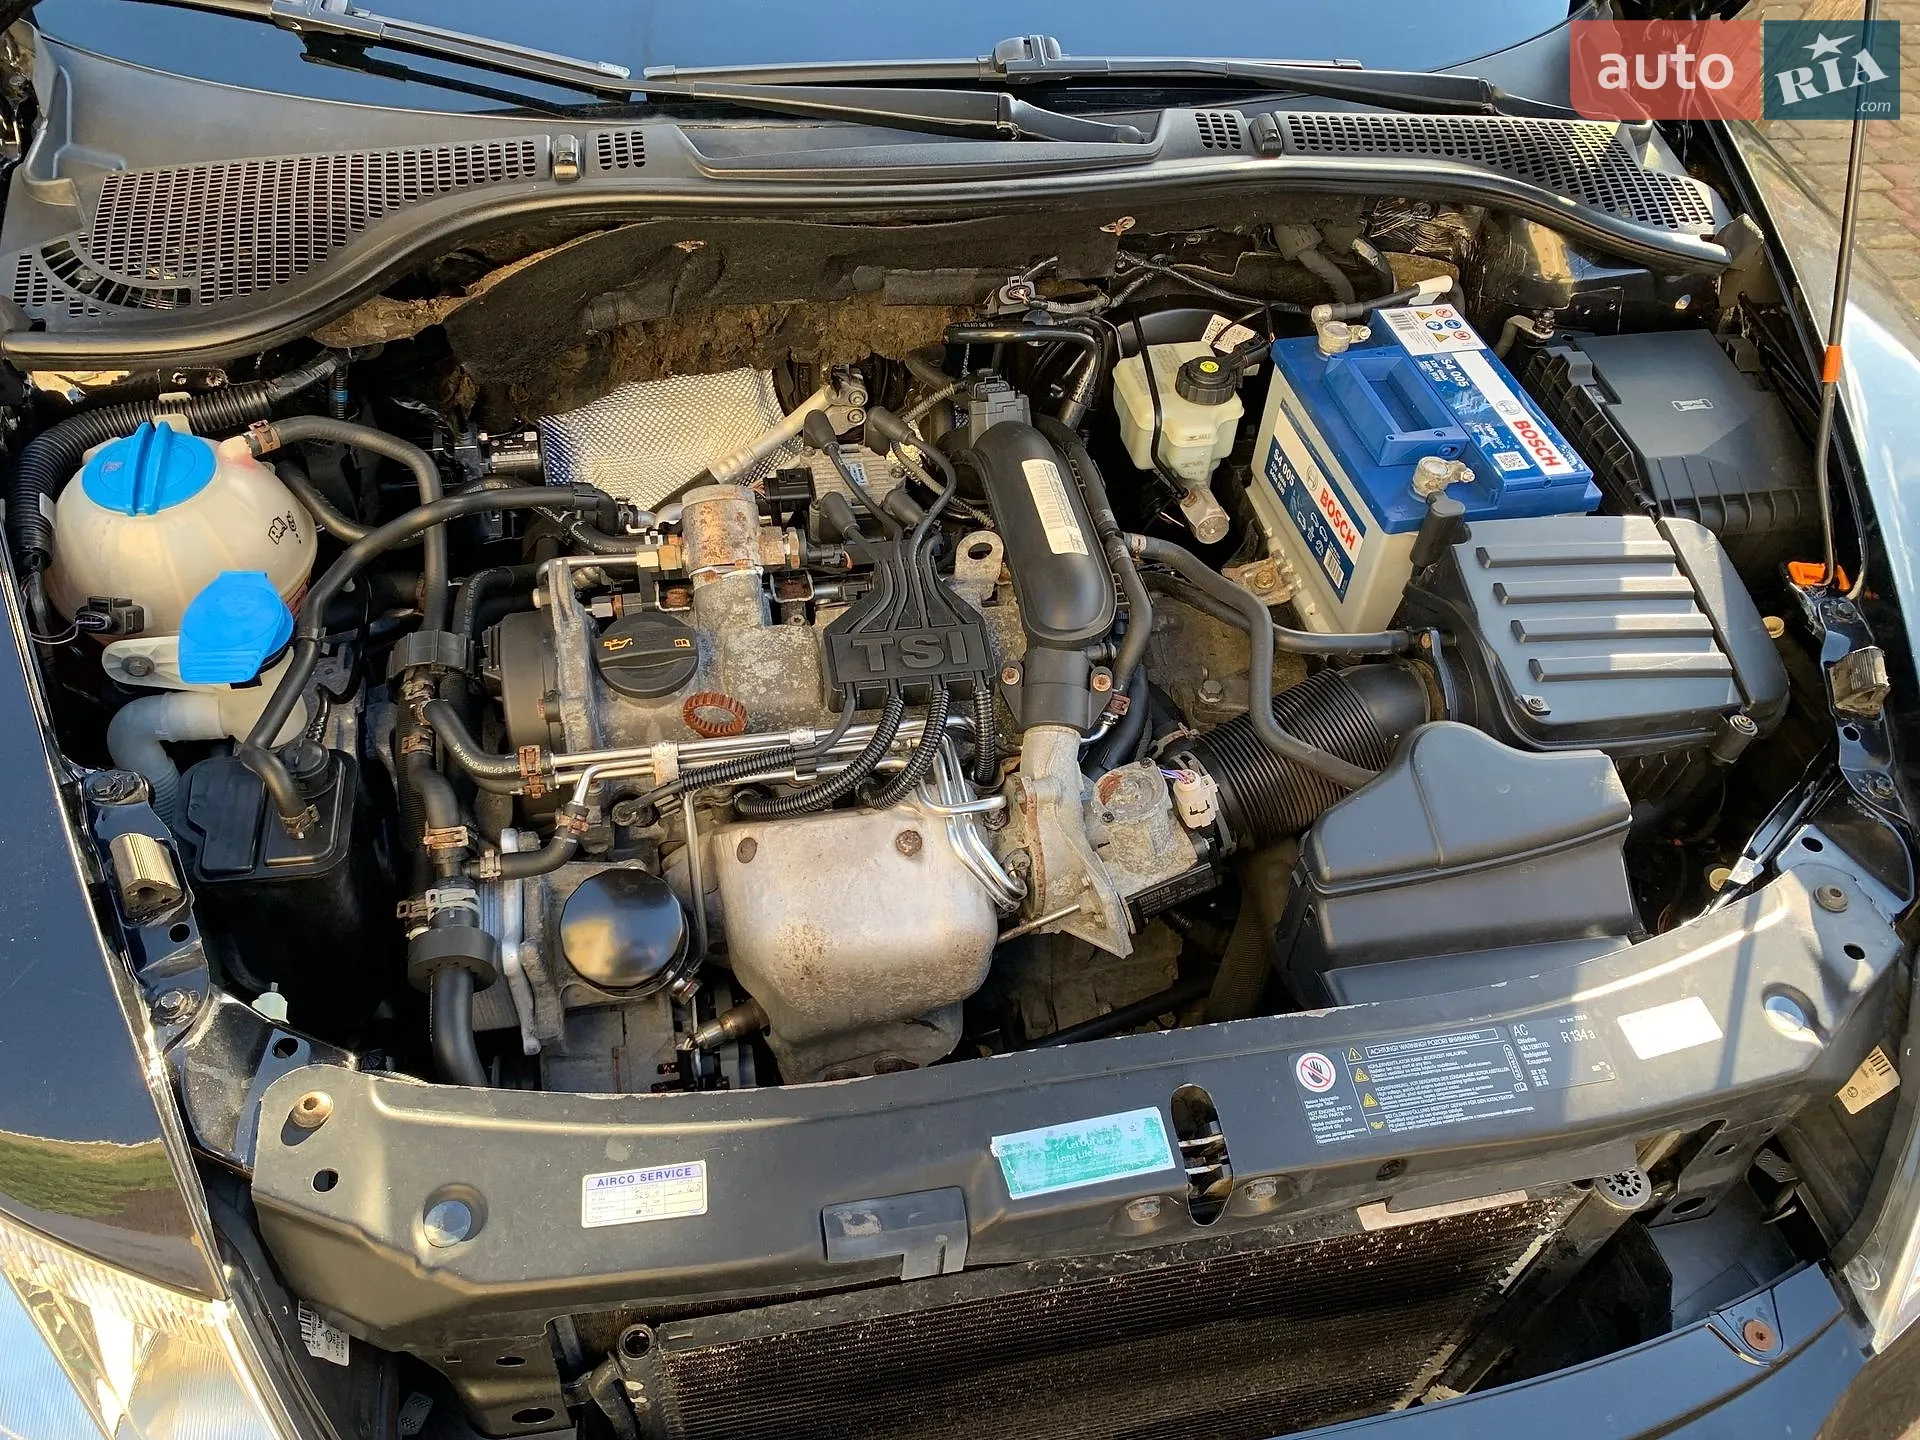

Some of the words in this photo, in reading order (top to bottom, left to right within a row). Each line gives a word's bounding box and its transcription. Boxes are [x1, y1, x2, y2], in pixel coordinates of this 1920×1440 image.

[1451, 371, 1470, 387] 005
[1513, 420, 1561, 466] BOSCH
[1274, 449, 1283, 466] S4
[1283, 463, 1295, 487] 005
[1319, 487, 1357, 551] BOSCH
[852, 631, 968, 671] TSI
[1513, 1024, 1529, 1037] AC
[597, 1175, 635, 1187] AIRCO
[640, 1167, 691, 1182] SERVICE
